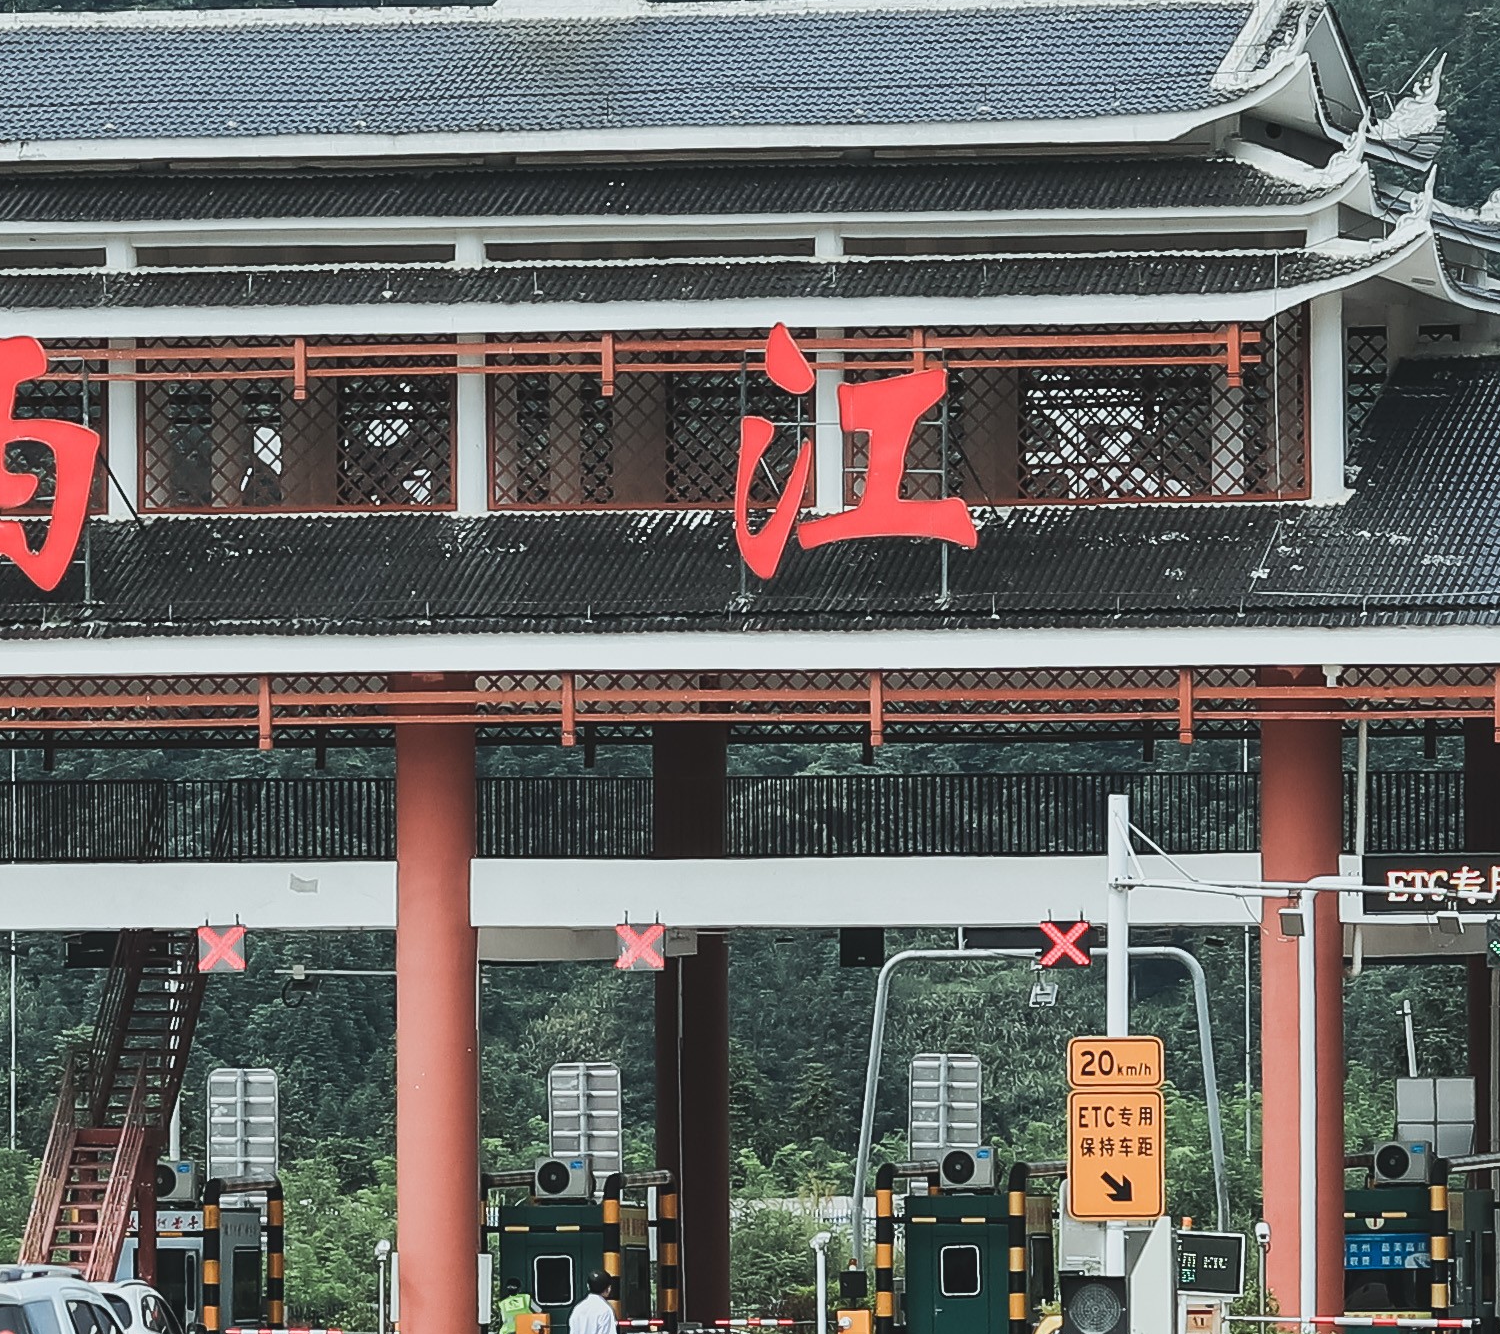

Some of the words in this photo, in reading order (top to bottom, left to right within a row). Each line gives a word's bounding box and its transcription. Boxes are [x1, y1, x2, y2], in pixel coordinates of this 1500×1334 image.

[1079, 1106, 1153, 1128] ETC专用
[1080, 1136, 1153, 1157] 保持车距
